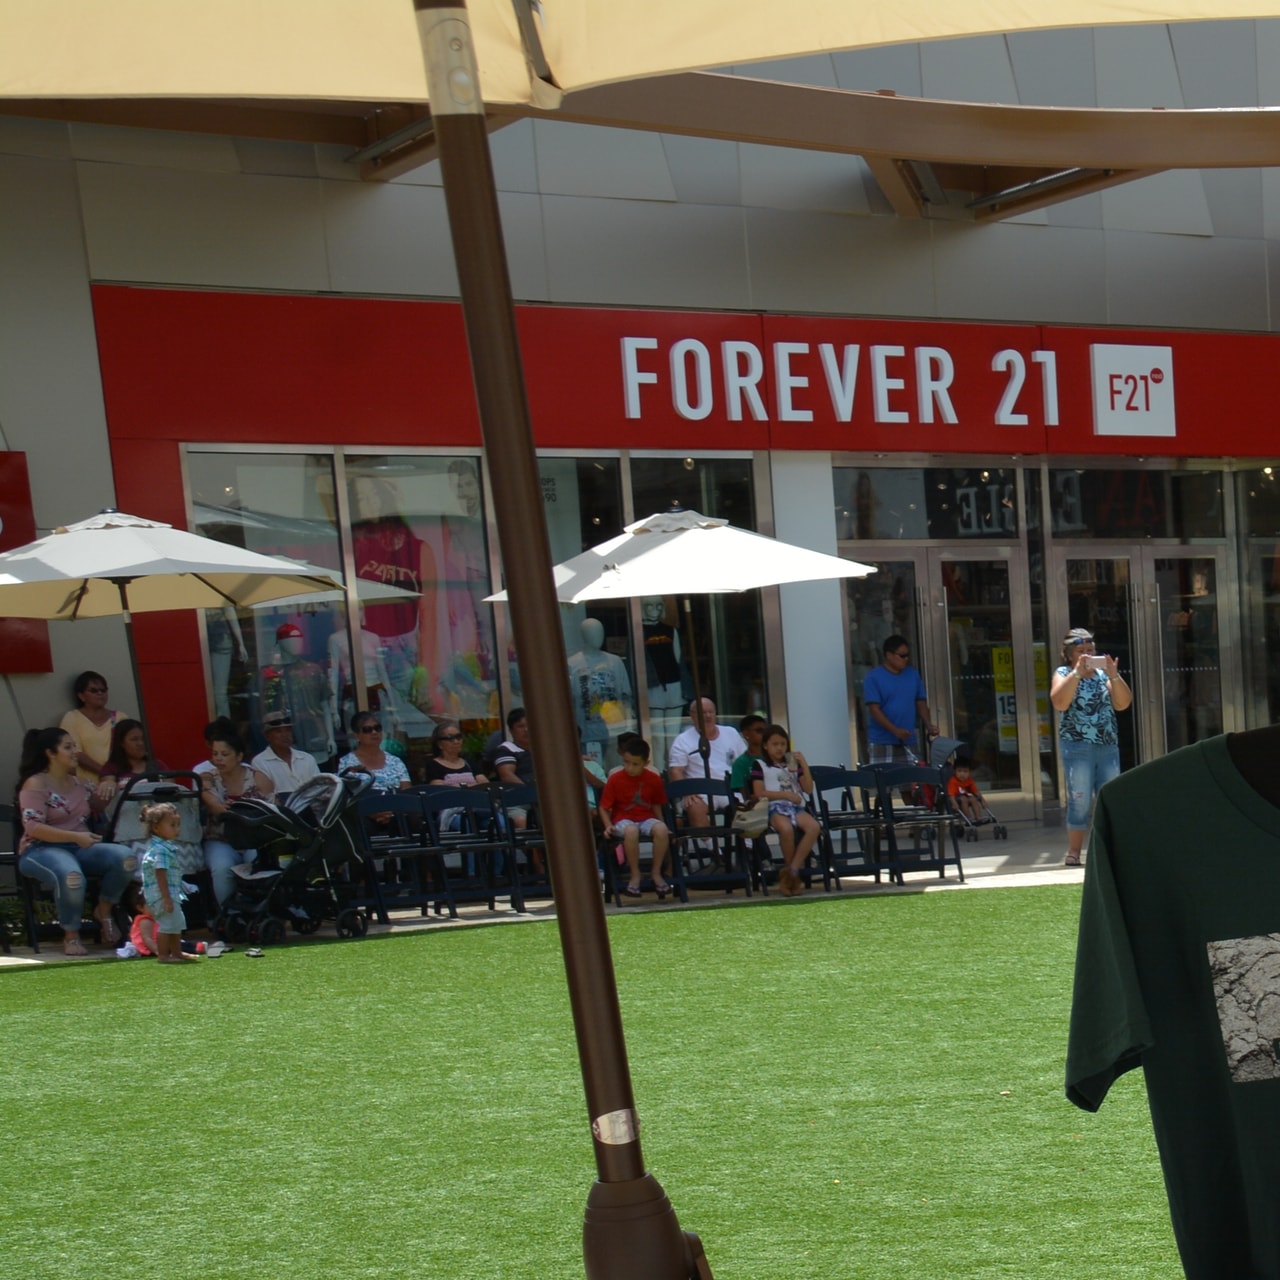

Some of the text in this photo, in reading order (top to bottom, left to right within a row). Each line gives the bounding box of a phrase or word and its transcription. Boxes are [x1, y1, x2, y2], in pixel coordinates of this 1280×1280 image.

[620, 336, 1060, 427] FOREVER 21
[1108, 372, 1150, 412] F21
